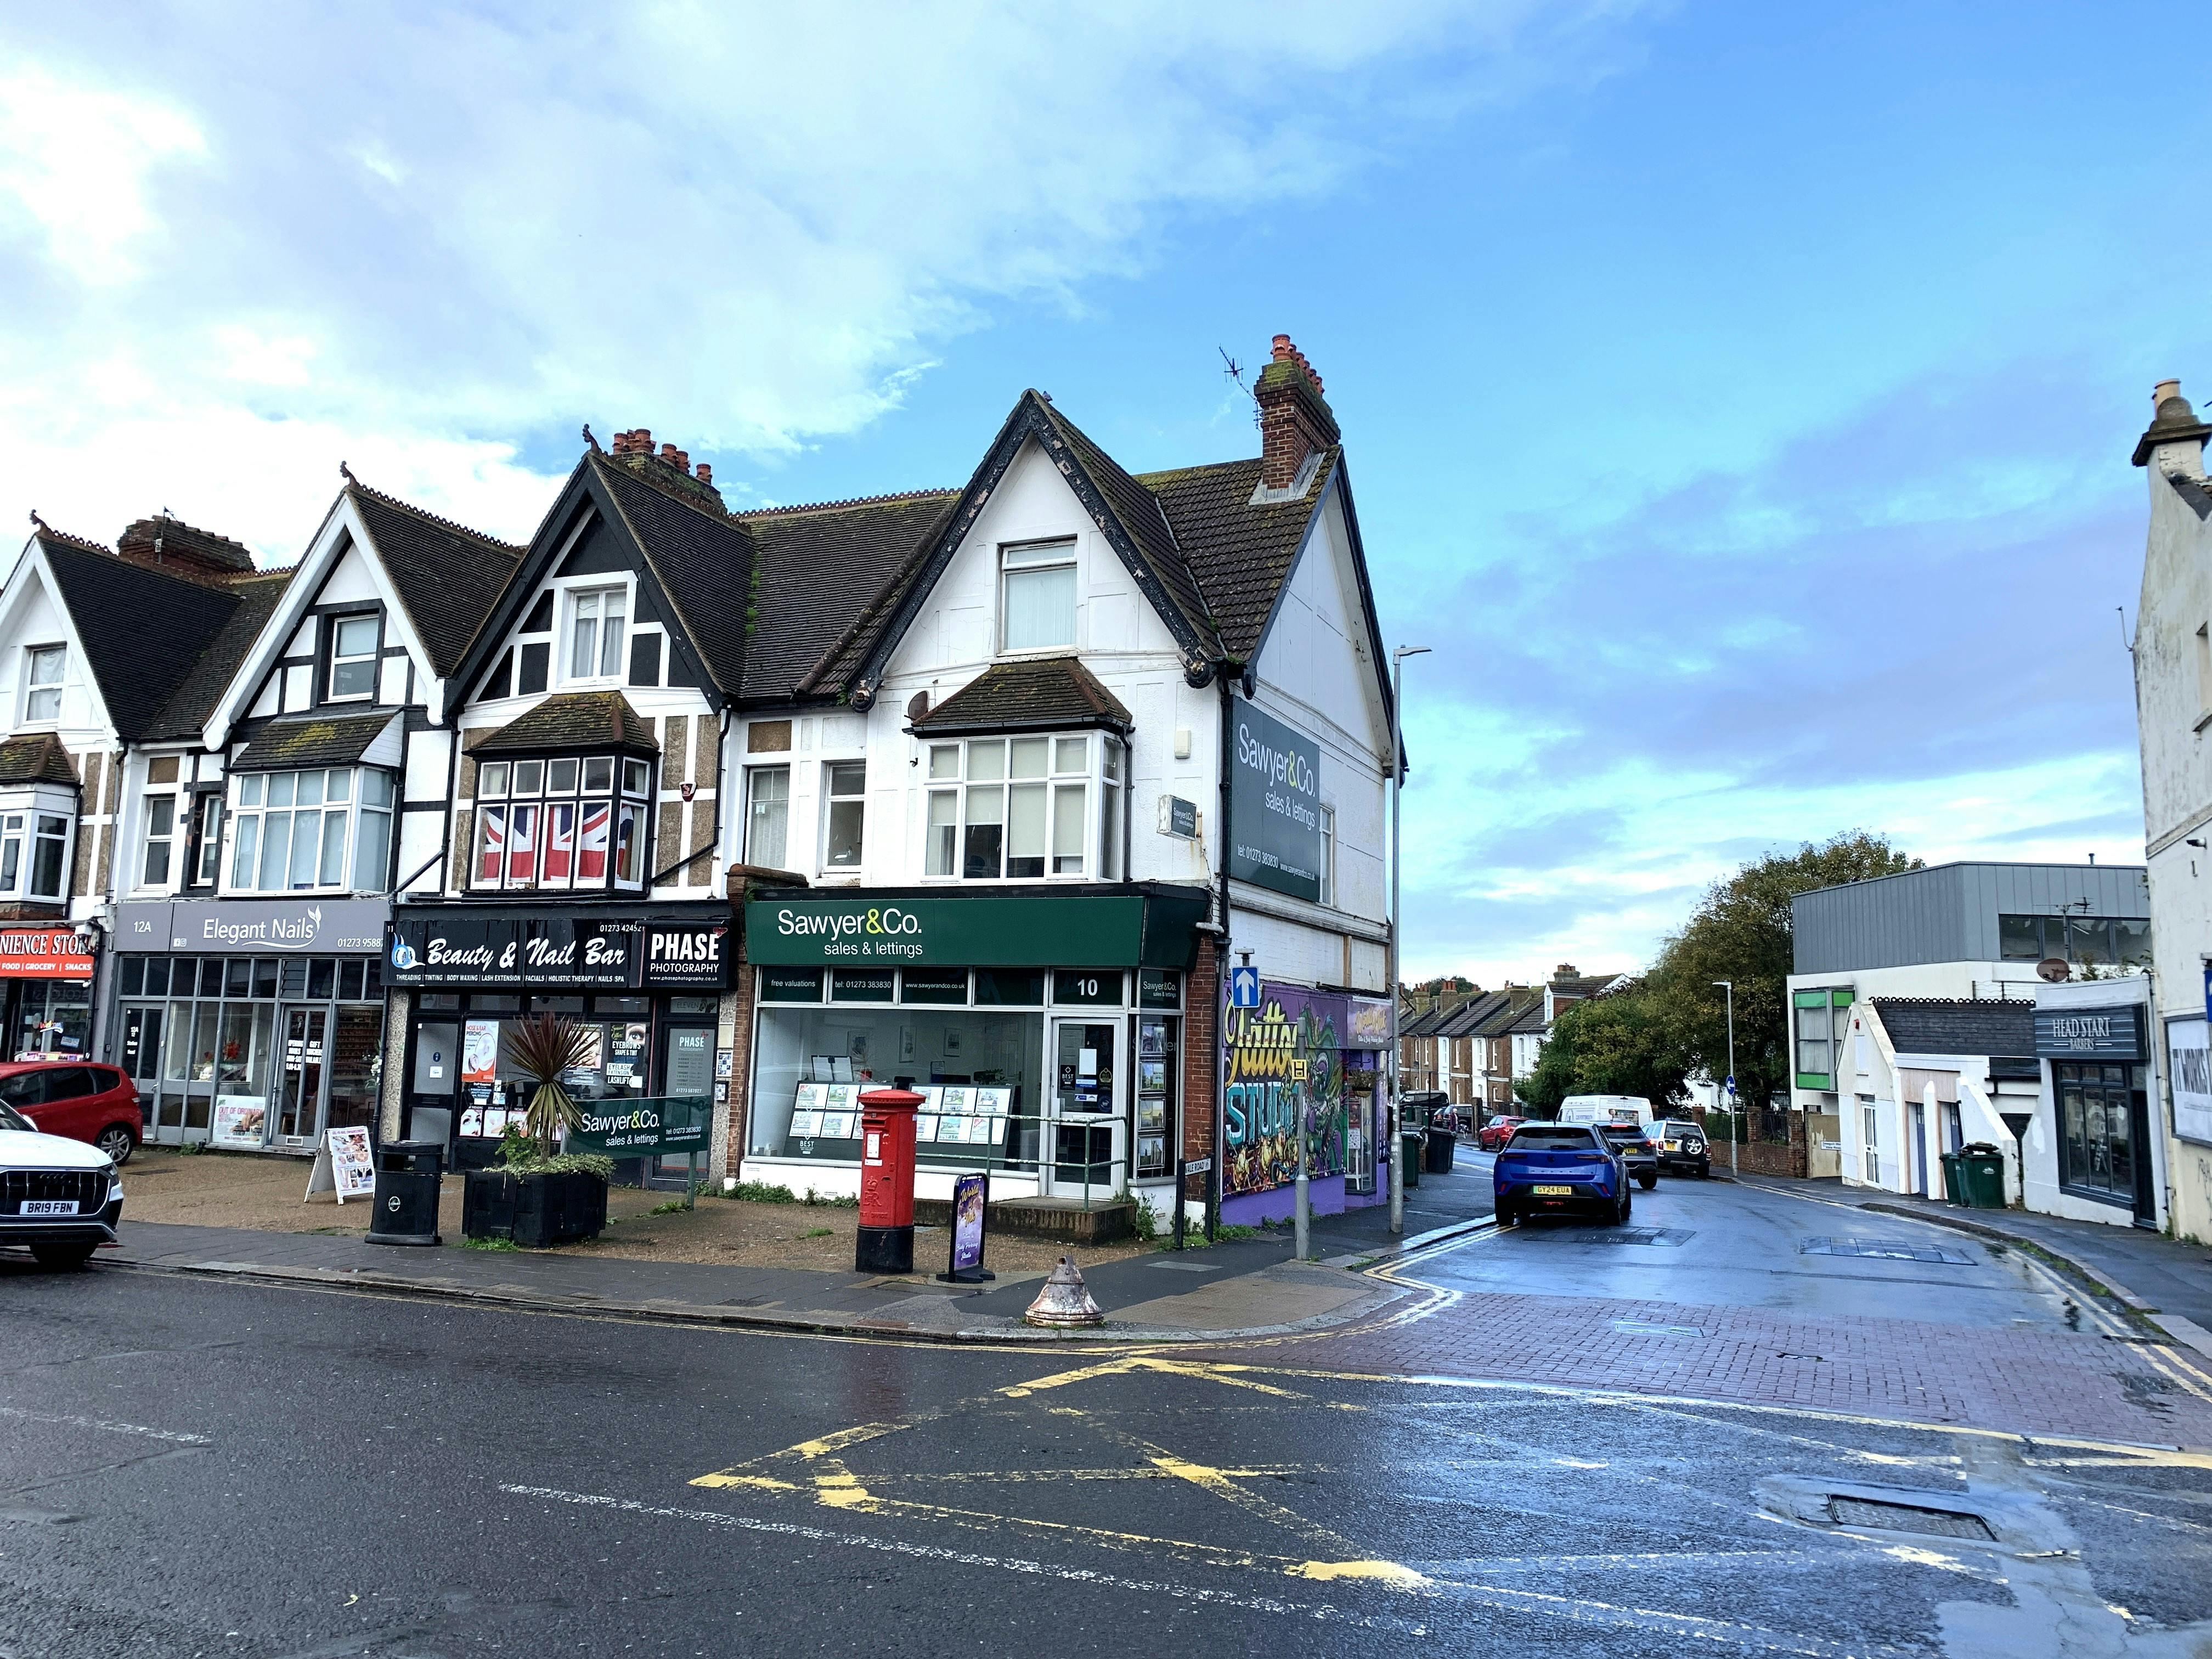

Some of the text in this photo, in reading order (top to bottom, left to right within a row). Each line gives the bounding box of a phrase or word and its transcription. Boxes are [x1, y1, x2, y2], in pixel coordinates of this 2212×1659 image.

[1239, 723, 1315, 797] Sawyer&Co.
[1173, 807, 1194, 821] Sawyer&Co.
[1265, 791, 1315, 831] sales & lettings
[1246, 847, 1261, 862] 01273
[1262, 852, 1279, 868] 383830
[133, 921, 151, 933] 12A
[203, 918, 314, 945] Elegant Nails
[778, 908, 922, 941] Sawyer&Co.
[337, 938, 360, 948] 01273
[650, 933, 719, 960] PHASE
[825, 941, 923, 958] sales & lettings
[427, 938, 625, 972] Beauty & Nail Bar
[650, 963, 719, 973] PHOTOGRAPHY
[1077, 979, 1098, 996] 10
[1143, 981, 1177, 991] Sawyer&Co.
[2053, 1018, 2111, 1037] HEAD START
[612, 1041, 641, 1049] EYEBROWS
[679, 1036, 704, 1047] PHASE
[582, 1110, 659, 1135] Sawyer&Co.
[606, 1133, 658, 1147] sales & lettings
[1194, 1161, 1204, 1171] ROAD
[27, 1203, 73, 1213] BR19 FBN
